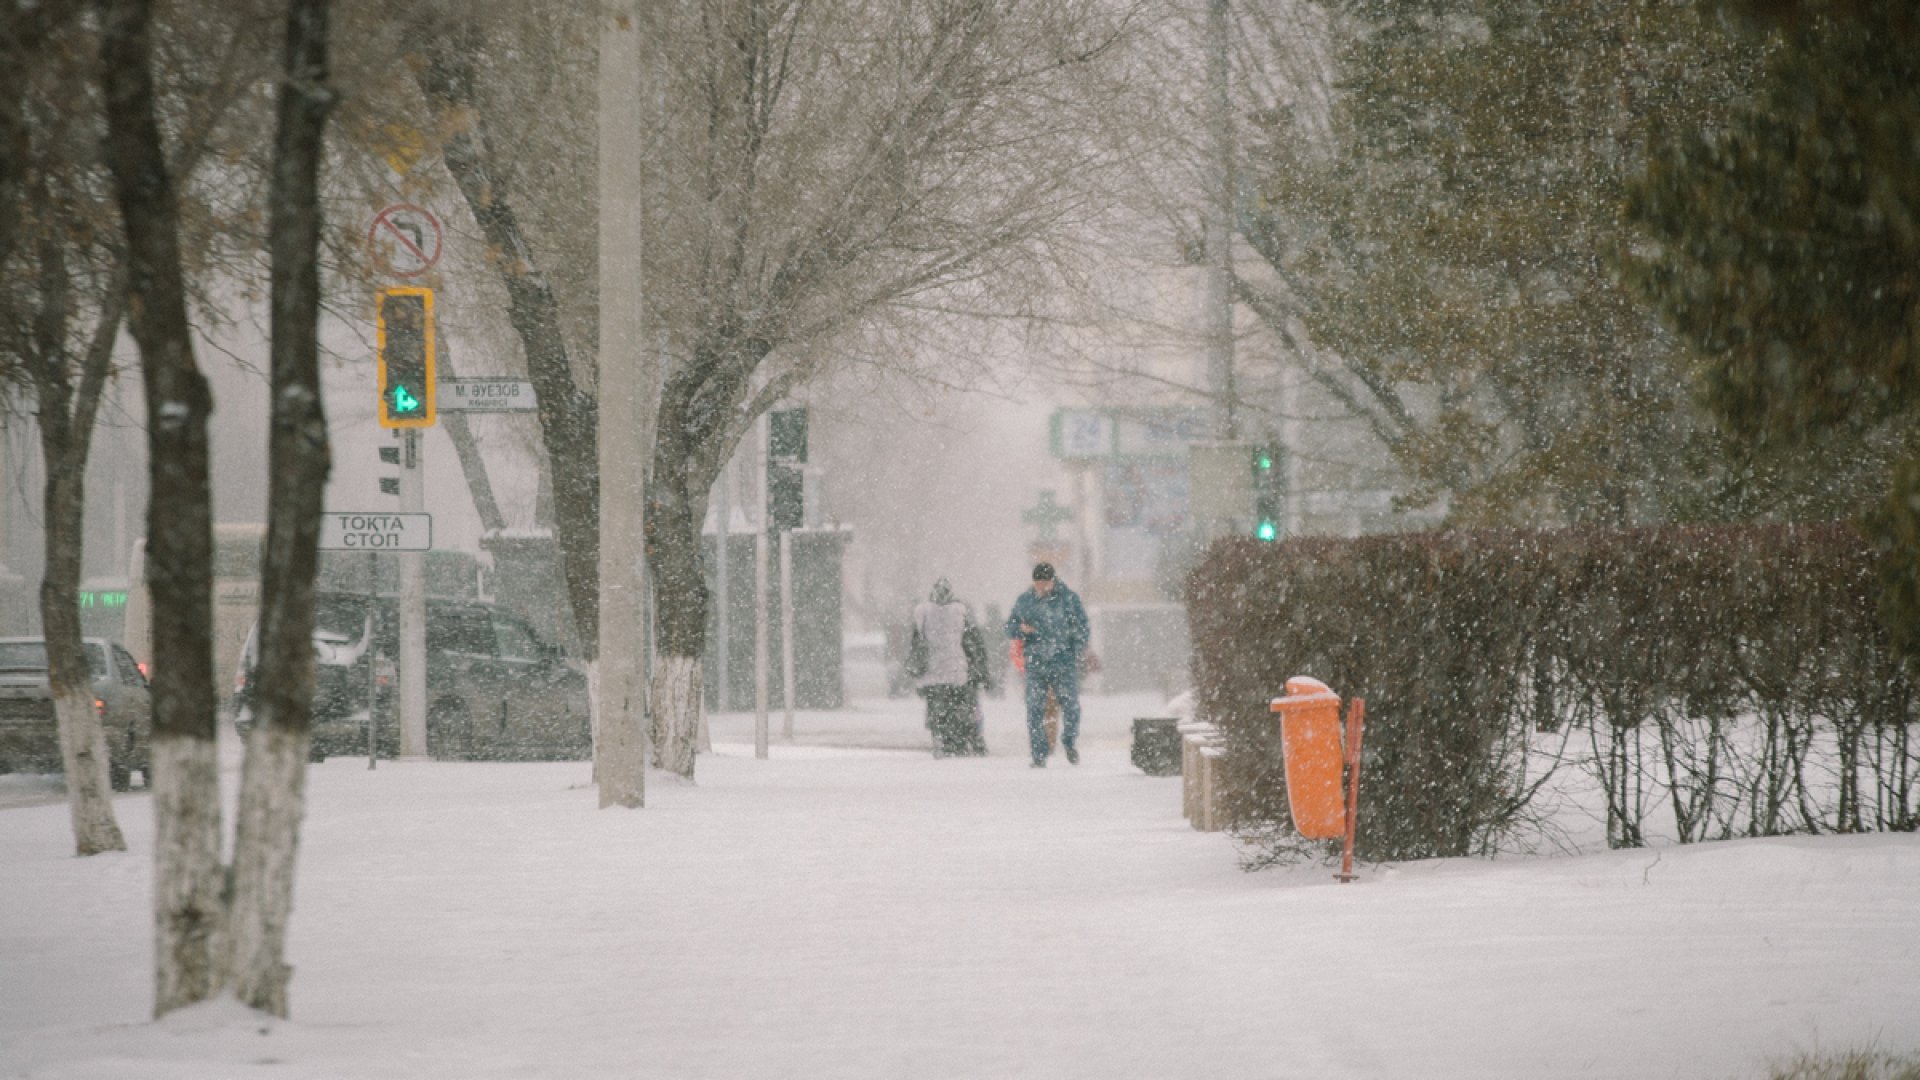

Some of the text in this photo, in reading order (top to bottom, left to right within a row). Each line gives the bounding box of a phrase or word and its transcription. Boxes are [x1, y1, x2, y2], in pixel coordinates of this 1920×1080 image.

[455, 384, 469, 397] М.
[338, 516, 404, 532] ТОҚТА
[343, 532, 399, 547] СТОП
